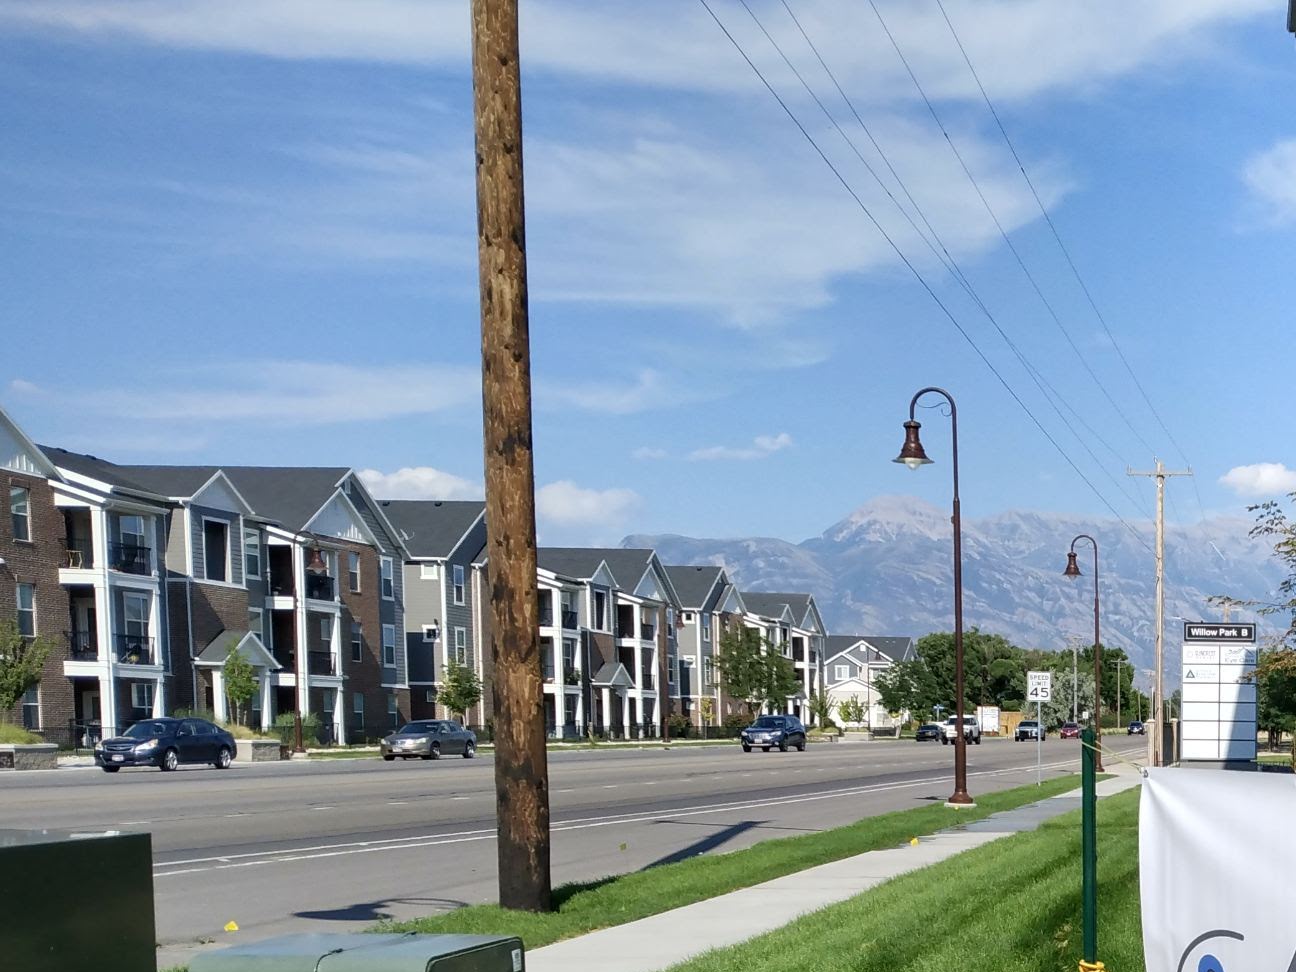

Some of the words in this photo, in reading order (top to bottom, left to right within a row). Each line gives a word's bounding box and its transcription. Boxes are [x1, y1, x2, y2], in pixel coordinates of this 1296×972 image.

[1190, 628, 1217, 636] Willow
[1219, 628, 1237, 636] Park
[1241, 628, 1248, 637] B
[1029, 687, 1049, 698] 45
